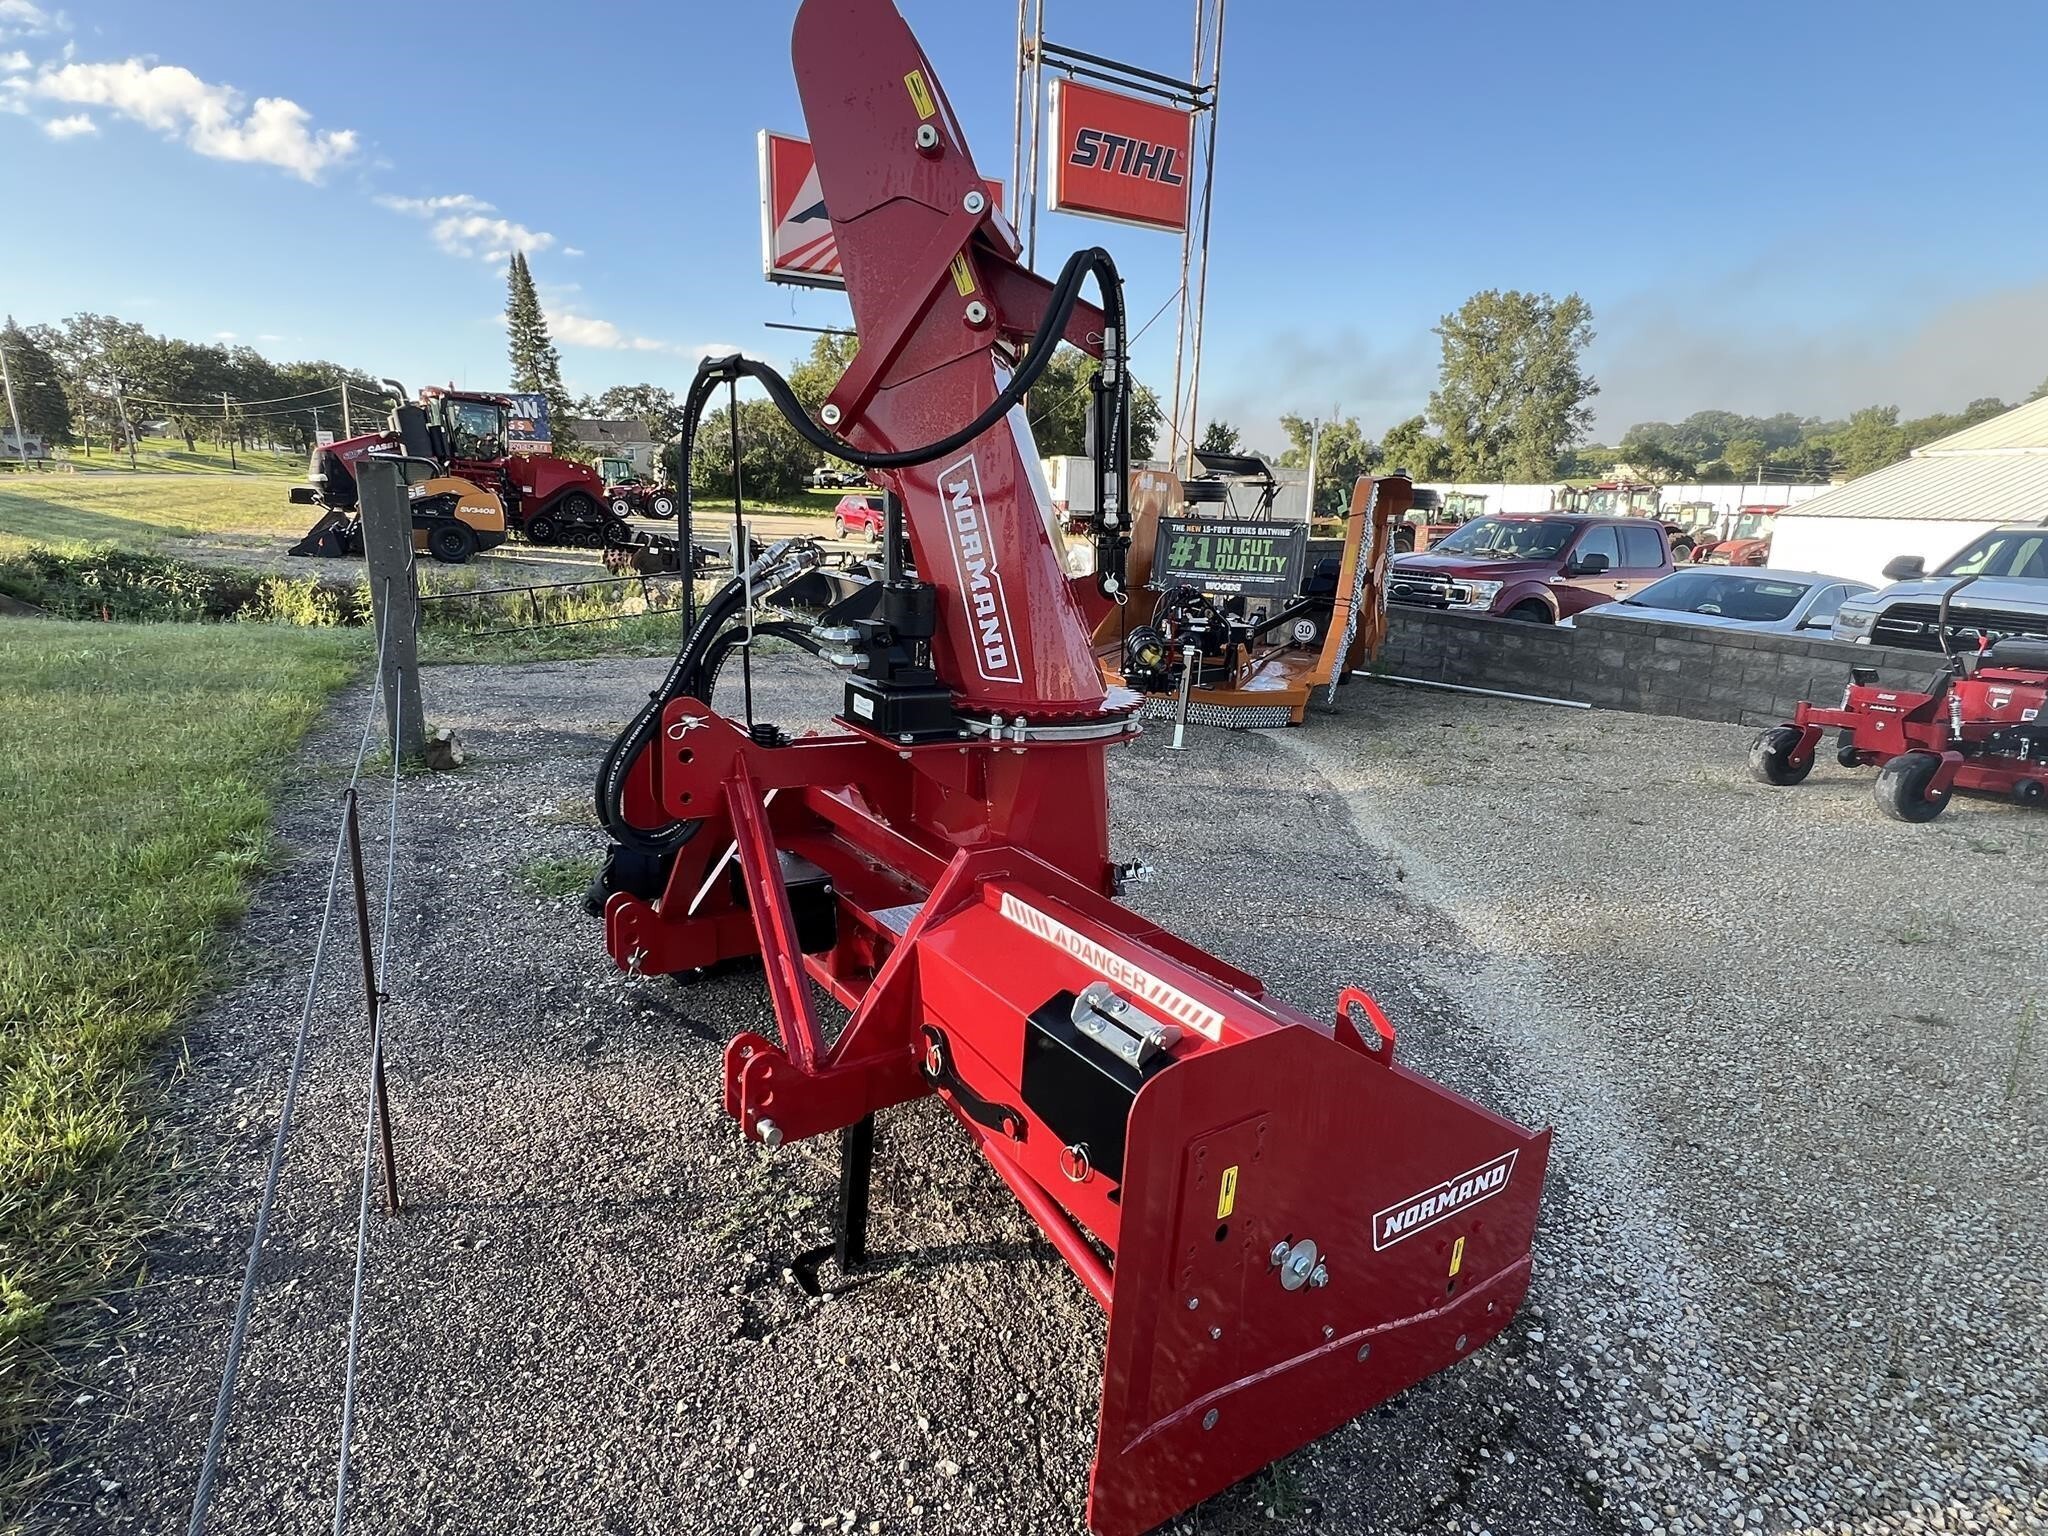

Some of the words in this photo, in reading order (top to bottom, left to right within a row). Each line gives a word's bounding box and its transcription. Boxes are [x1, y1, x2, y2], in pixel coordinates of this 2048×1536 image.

[1069, 127, 1184, 187] STIHL
[508, 400, 539, 419] AN
[367, 442, 393, 453] CASE
[408, 485, 426, 499] SE
[1172, 524, 1185, 532] THE
[1186, 525, 1201, 533] NEW
[1232, 527, 1256, 535] SERIES
[1168, 536, 1211, 569] #1
[1216, 538, 1235, 554] IN
[1240, 538, 1273, 556] CUT
[1214, 554, 1287, 573] QUALITY
[948, 479, 1008, 670] NORMAND
[1205, 581, 1242, 592] WOODS
[1297, 625, 1311, 635] 30
[1069, 935, 1147, 995] DANGER
[1382, 1164, 1506, 1239] NORMAND
